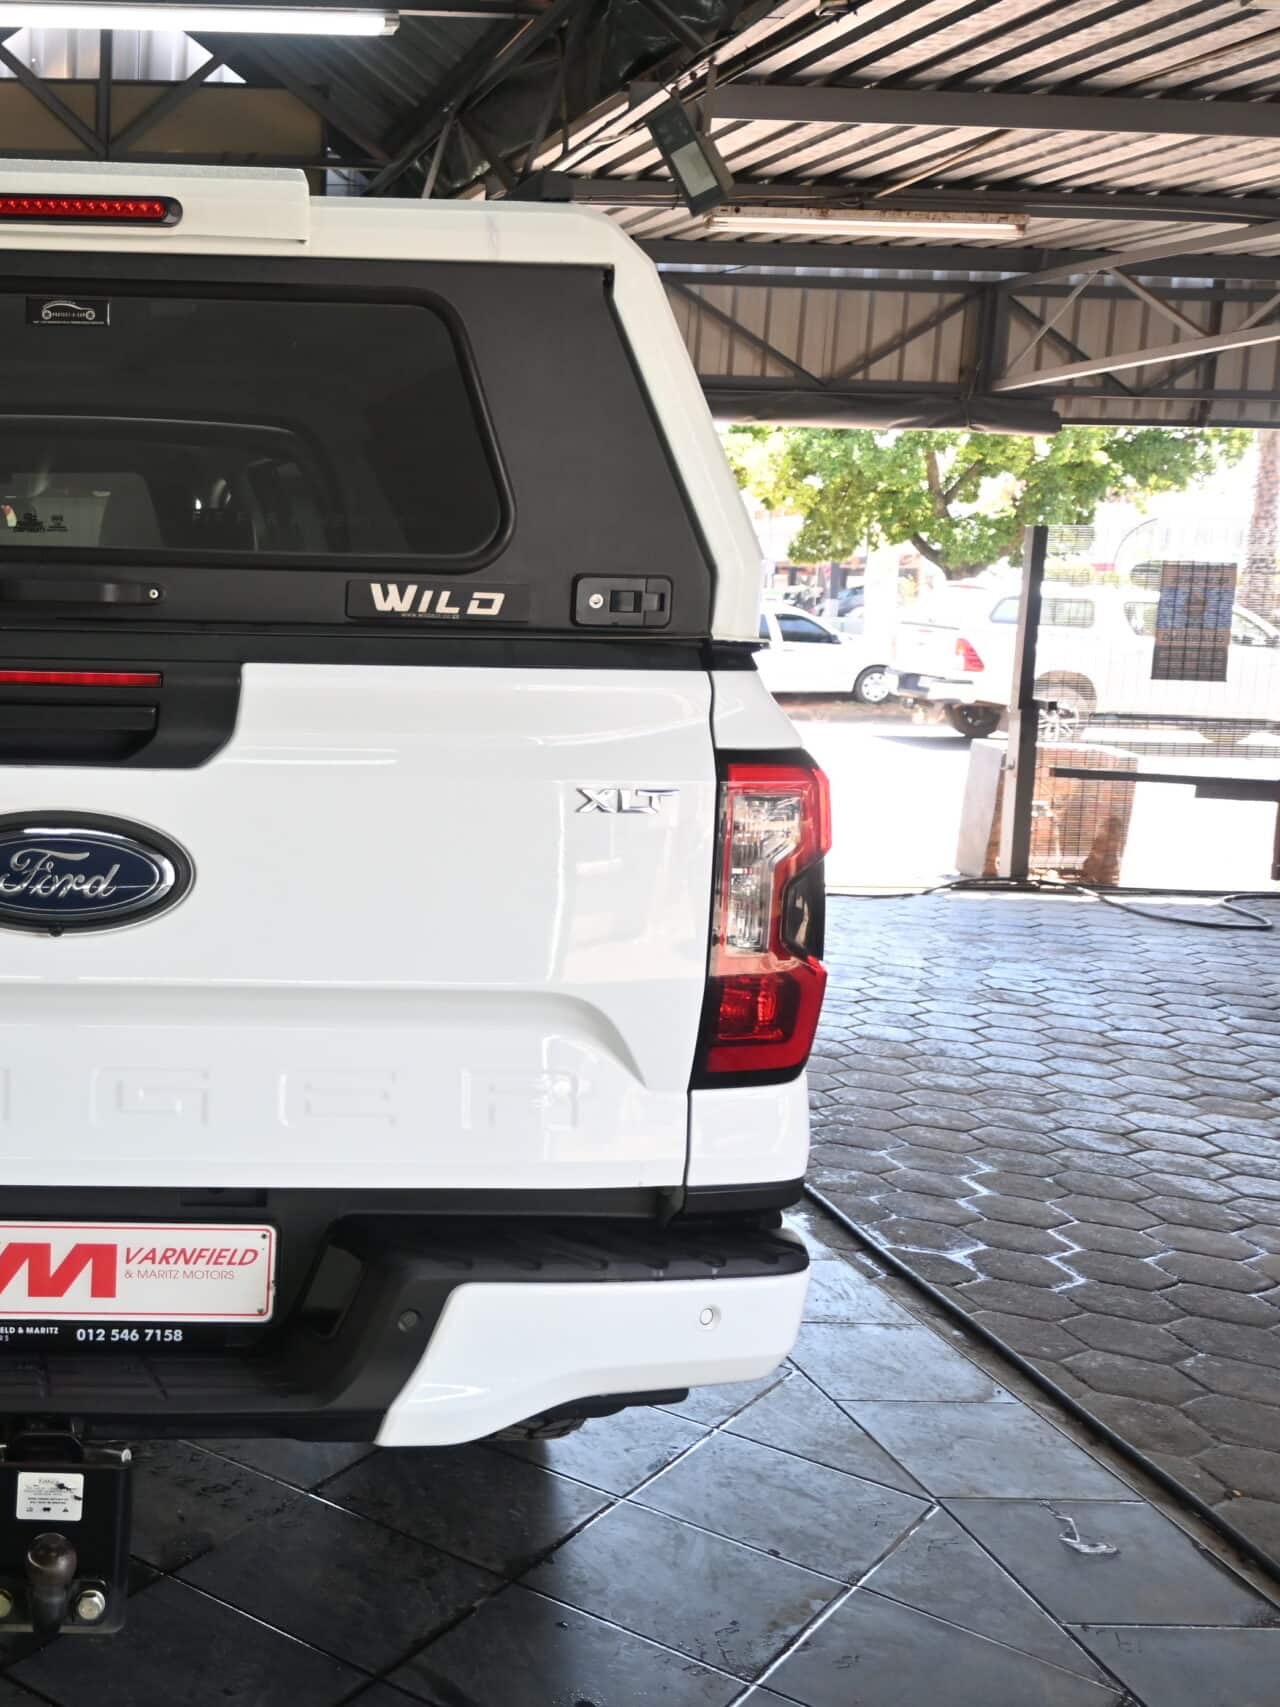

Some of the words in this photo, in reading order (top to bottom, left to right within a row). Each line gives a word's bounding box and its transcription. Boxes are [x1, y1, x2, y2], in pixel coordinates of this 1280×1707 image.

[370, 583, 505, 616] WILD
[575, 787, 681, 813] XLT
[124, 1247, 259, 1266] VARNFIELD
[124, 1269, 133, 1280] &
[137, 1269, 179, 1280] MARITZ
[182, 1269, 235, 1280] MOTORS
[26, 1326, 59, 1335] MARITZ
[76, 1329, 106, 1342] 012
[110, 1329, 140, 1342] 546
[144, 1329, 183, 1342] 7158
